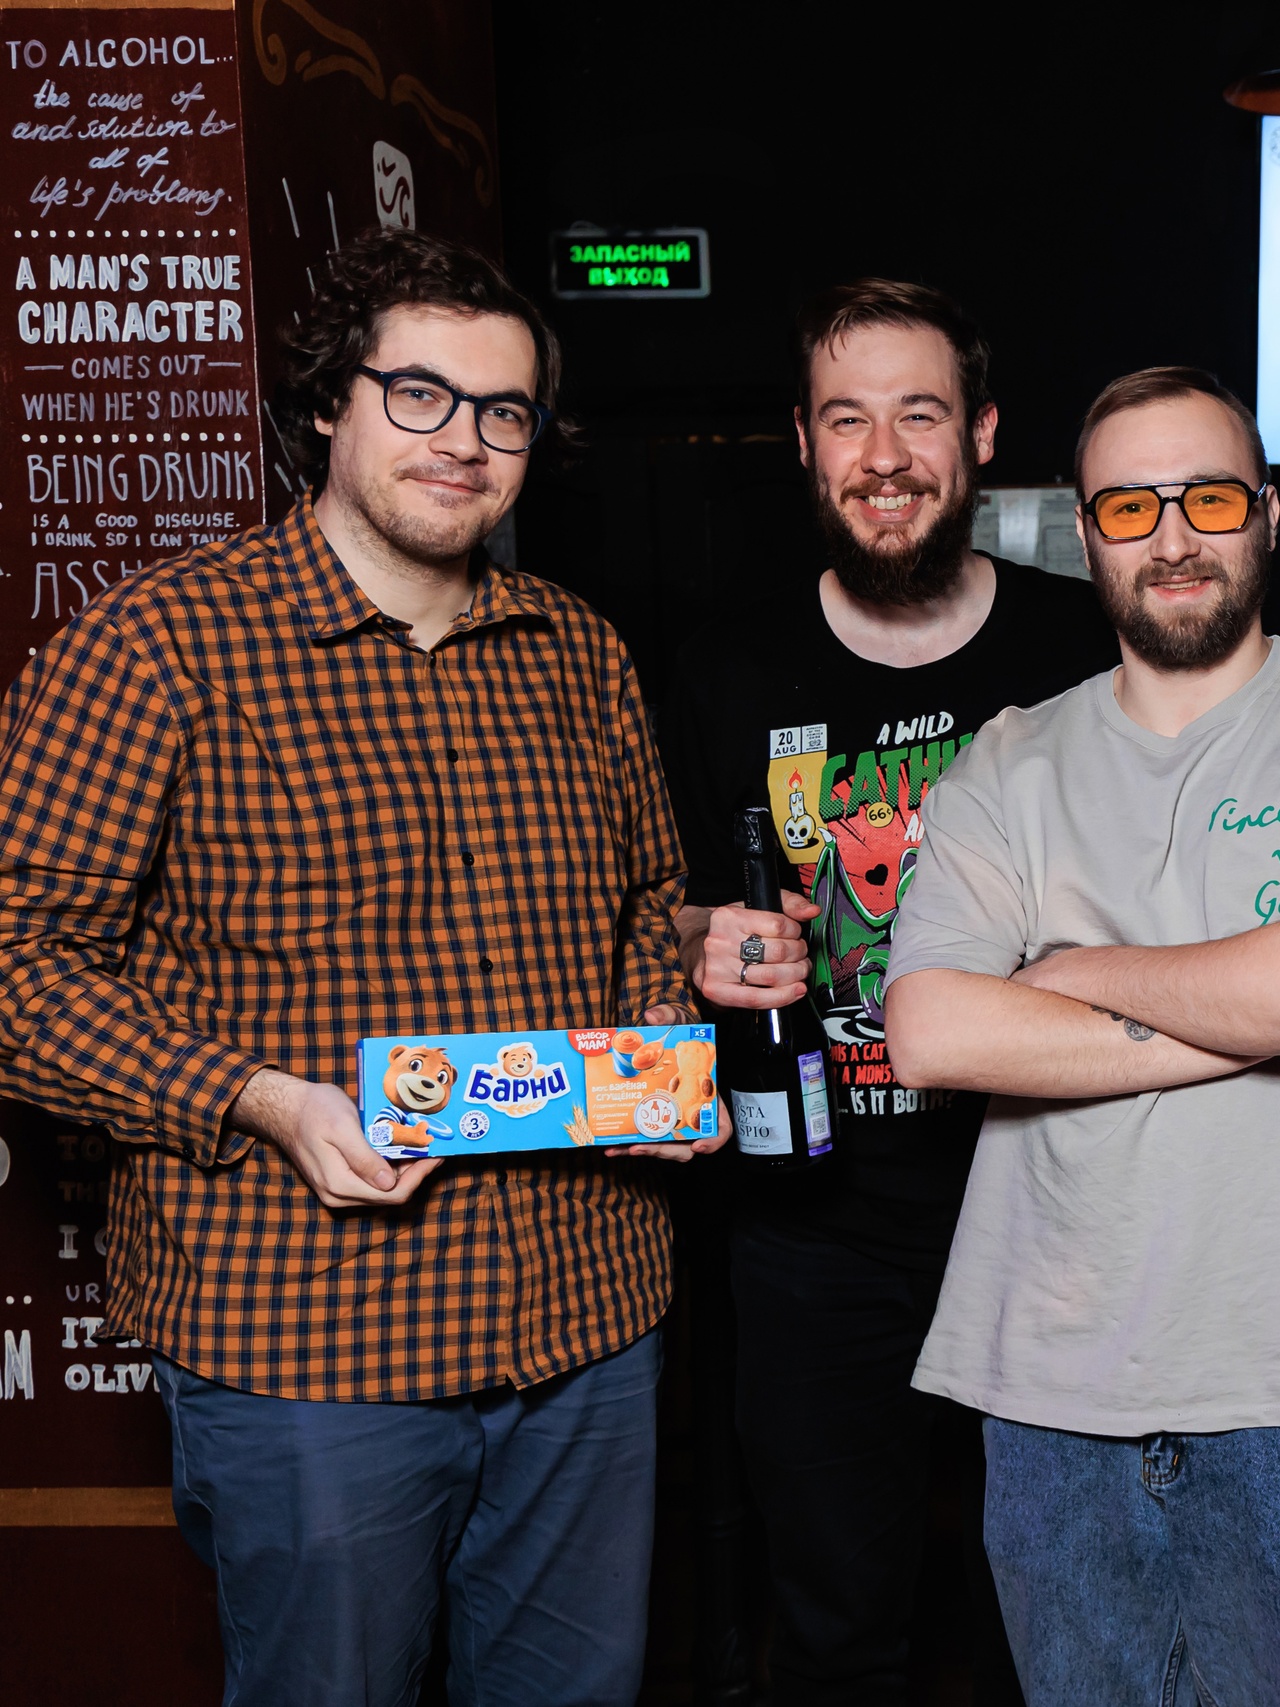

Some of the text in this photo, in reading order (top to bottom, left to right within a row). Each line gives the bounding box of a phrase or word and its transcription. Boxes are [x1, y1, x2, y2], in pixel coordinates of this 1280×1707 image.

[6, 40, 47, 69] TO
[33, 79, 205, 113] the cause of
[11, 108, 236, 141] and solution to
[88, 147, 169, 177] all of
[30, 175, 95, 218] life's
[570, 241, 690, 262] ЗАПАСНЫЙ
[15, 253, 241, 291] A MAN'S TRUE
[588, 266, 669, 287] ВЫХОД
[17, 299, 244, 344] CHARACTER
[71, 354, 206, 380] COMES OUT
[21, 389, 250, 422] WHEN HE'S DRUNK
[27, 451, 255, 504] BEING DRUNK
[33, 512, 241, 529] IS A GOOD DISGUISE.
[31, 532, 38, 546] I
[45, 532, 97, 548] DRINK
[105, 533, 129, 546] SO
[135, 535, 141, 547] I
[150, 533, 182, 547] CAN
[779, 731, 793, 746] 20
[876, 711, 954, 745] A WILD
[774, 745, 797, 756] AUG
[575, 1032, 609, 1040] ВЫБОР
[851, 1045, 859, 1062] A
[863, 1043, 886, 1061] CAT
[469, 1067, 566, 1102] Барни
[842, 1066, 850, 1085] A
[855, 1064, 897, 1085] MONS
[470, 1118, 479, 1130] 3
[64, 1363, 161, 1393] OLIV
